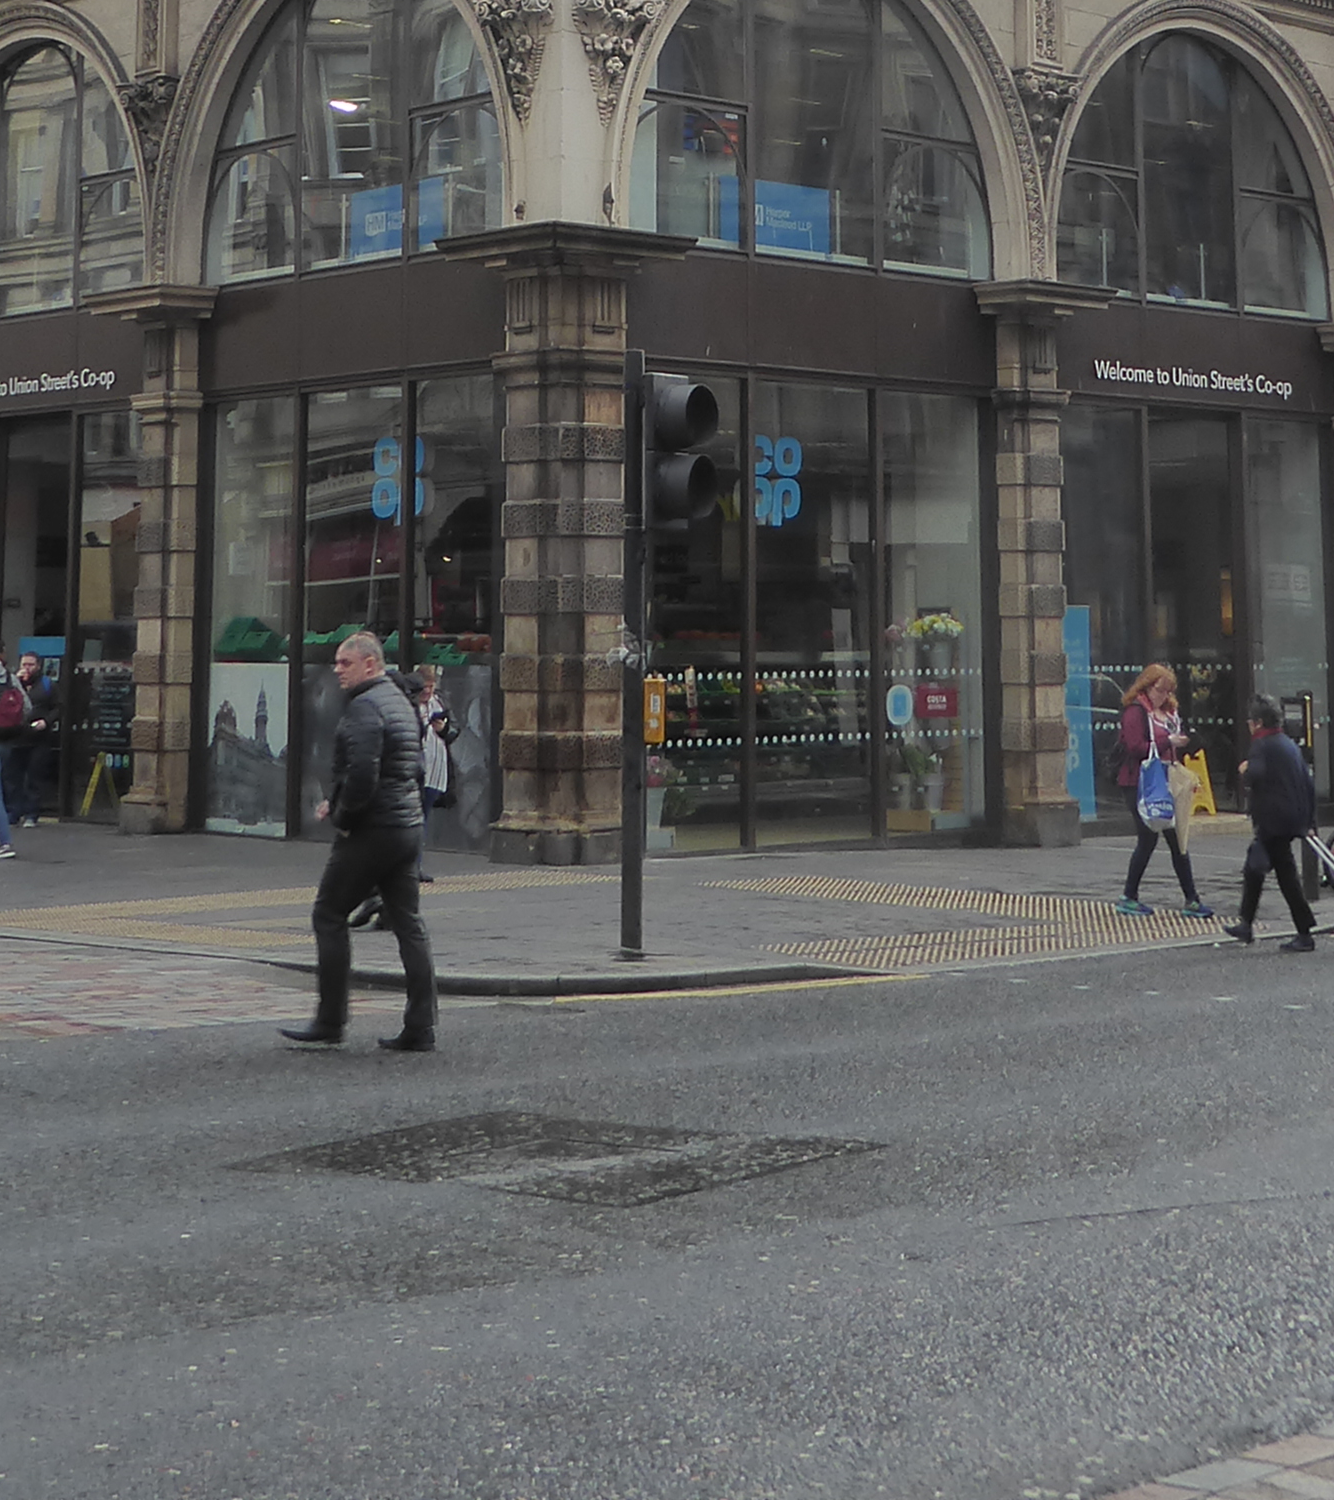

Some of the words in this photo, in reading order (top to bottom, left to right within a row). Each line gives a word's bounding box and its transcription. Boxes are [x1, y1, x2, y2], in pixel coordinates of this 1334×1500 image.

[9, 376, 39, 396] Union
[40, 370, 79, 393] Street's
[80, 368, 116, 391] Co-op
[1094, 359, 1154, 384] Welcome
[1156, 367, 1170, 385] to
[1172, 367, 1208, 389] Union
[1210, 371, 1254, 393] Street's
[1255, 374, 1293, 400] Co-op
[927, 694, 947, 704] COSTA
